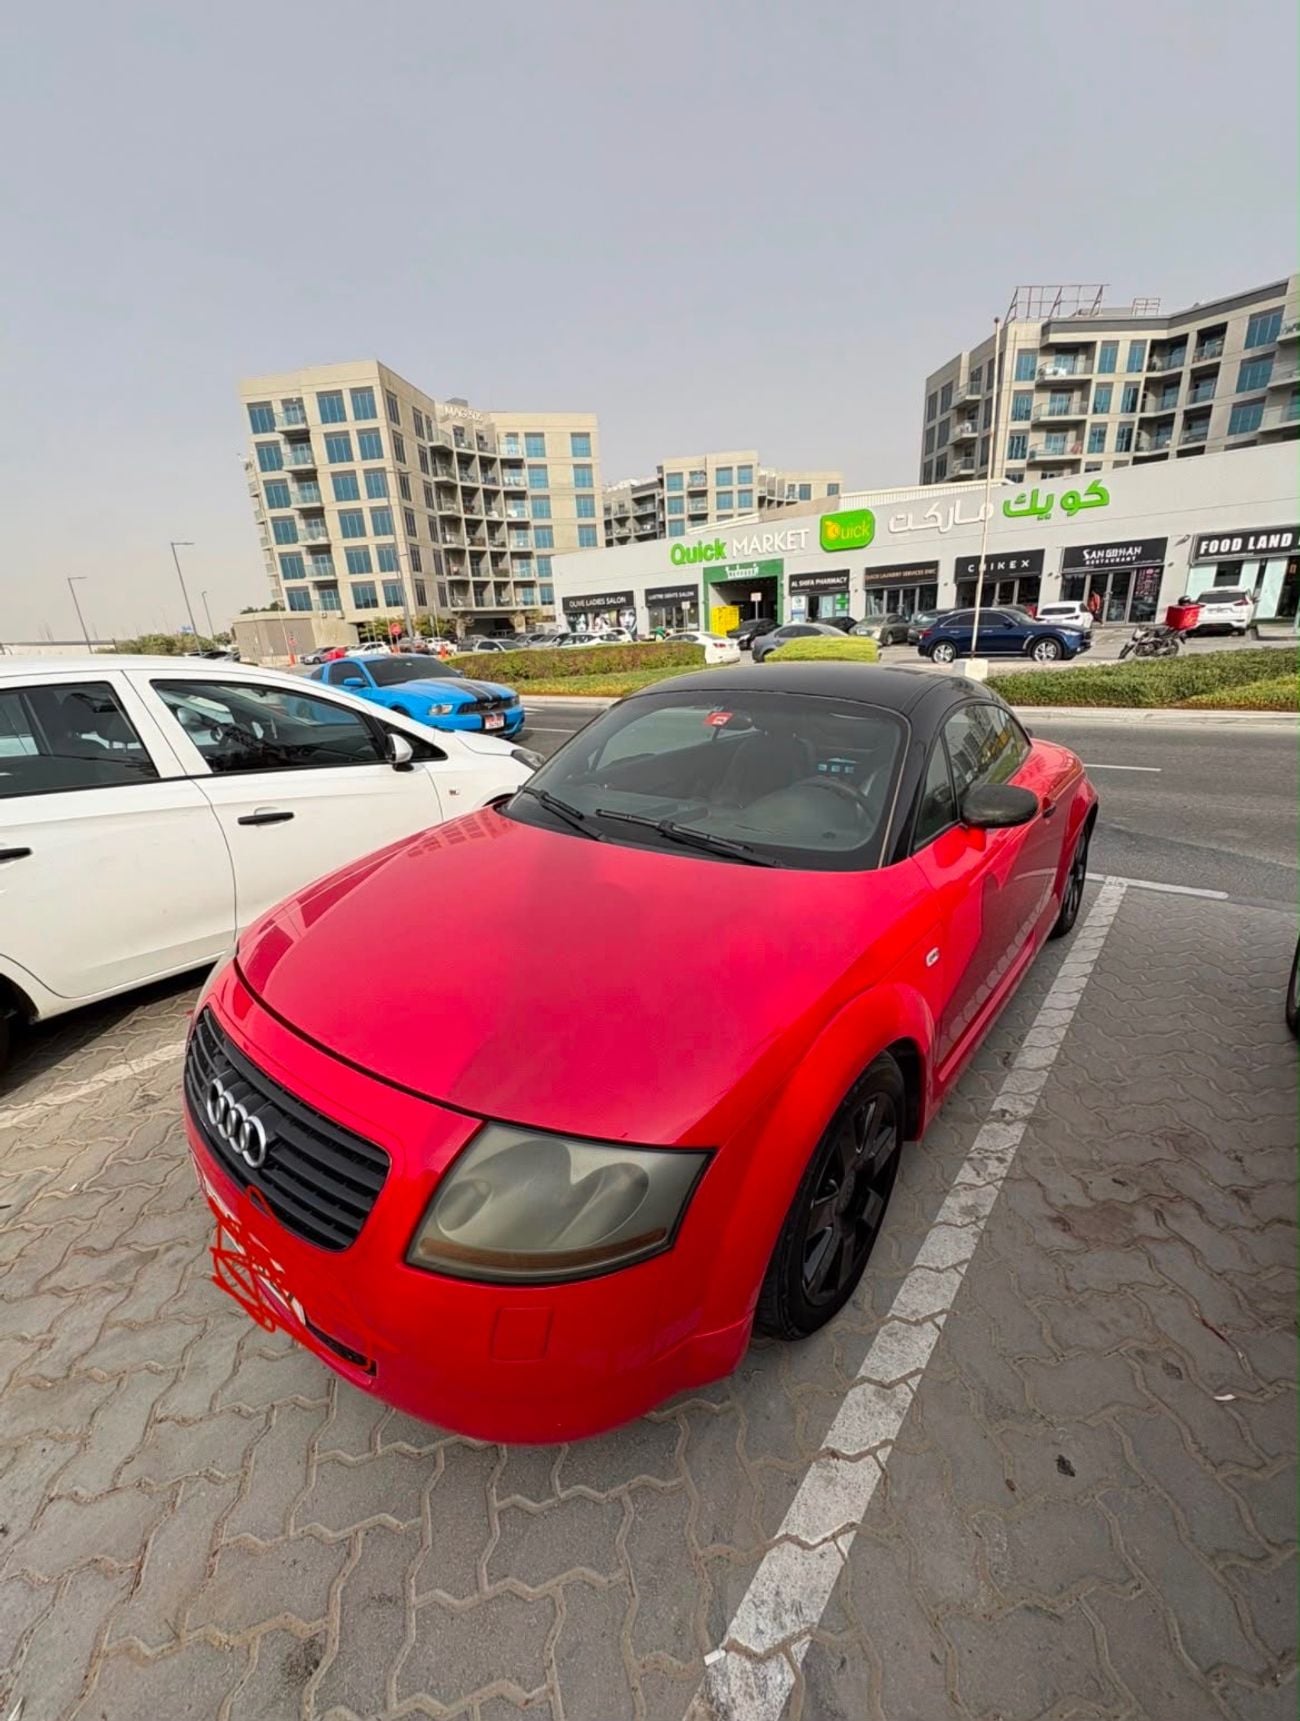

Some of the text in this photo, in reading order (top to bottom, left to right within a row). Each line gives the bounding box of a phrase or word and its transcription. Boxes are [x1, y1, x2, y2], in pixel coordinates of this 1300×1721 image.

[1003, 479, 1110, 520] كويك
[670, 530, 809, 566] Quick MARKET
[1199, 533, 1293, 555] FOOD LAND
[815, 576, 848, 585] PHARMACY
[586, 598, 605, 606] LADIES
[606, 596, 627, 604] SALON
